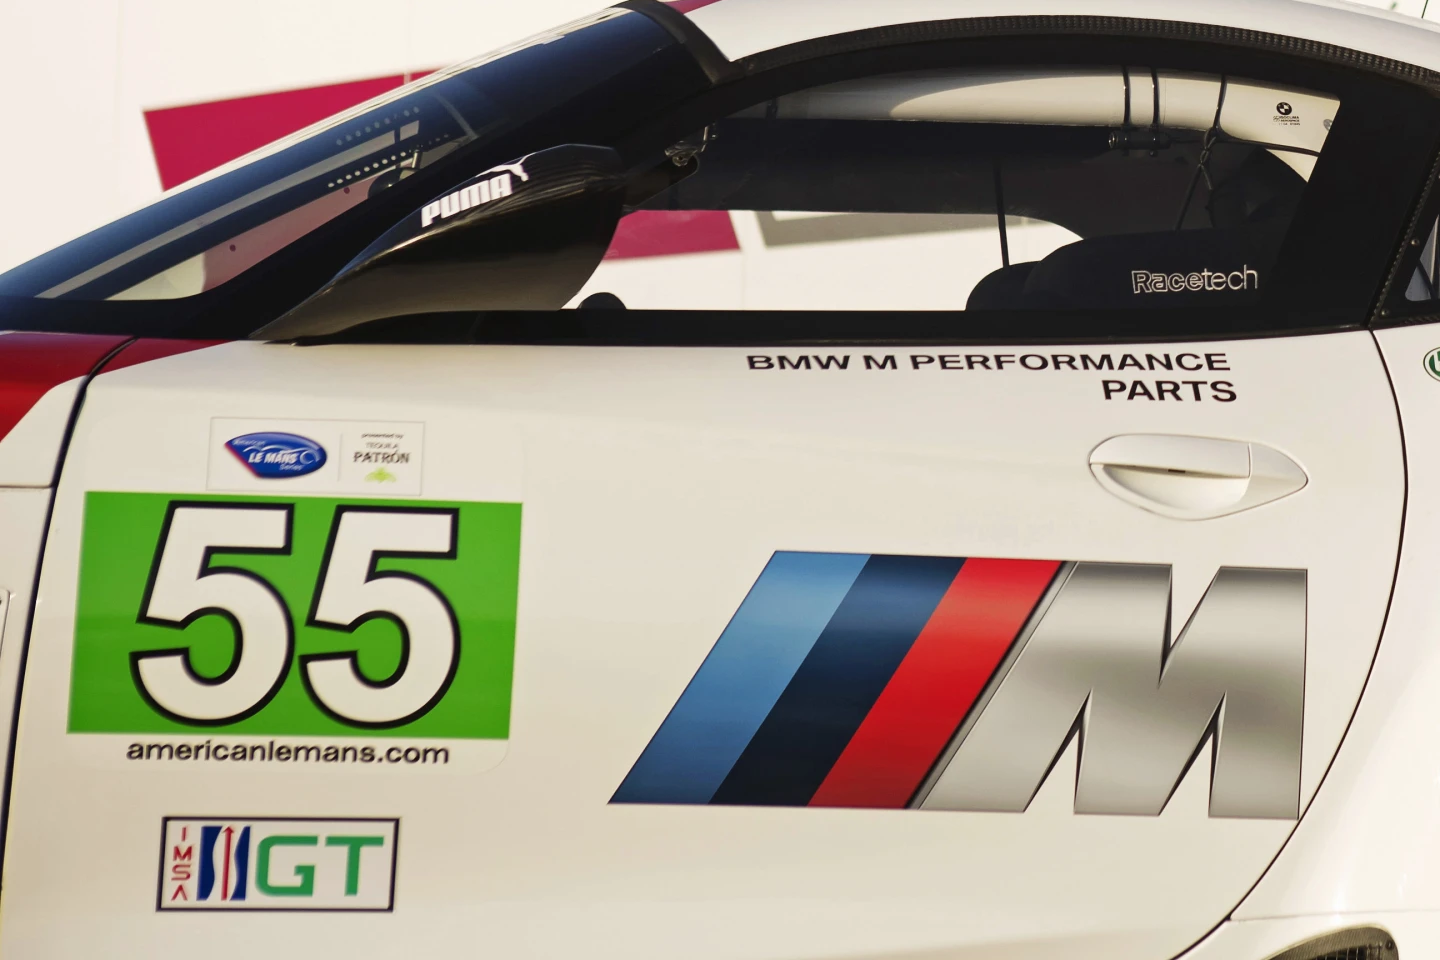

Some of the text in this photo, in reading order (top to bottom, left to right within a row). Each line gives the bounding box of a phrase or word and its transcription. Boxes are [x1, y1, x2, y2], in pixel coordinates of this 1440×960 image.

[421, 173, 512, 228] PUMA
[1131, 264, 1258, 294] Racetech
[746, 353, 1232, 372] BMW M PERFORMANCE
[1101, 380, 1237, 403] PARTS
[248, 451, 299, 465] LE MANS
[353, 449, 411, 464] PATRÓN
[129, 500, 462, 730] 55
[913, 561, 1307, 820] M
[126, 739, 450, 766] americanlemans.com
[254, 835, 385, 898] GT
